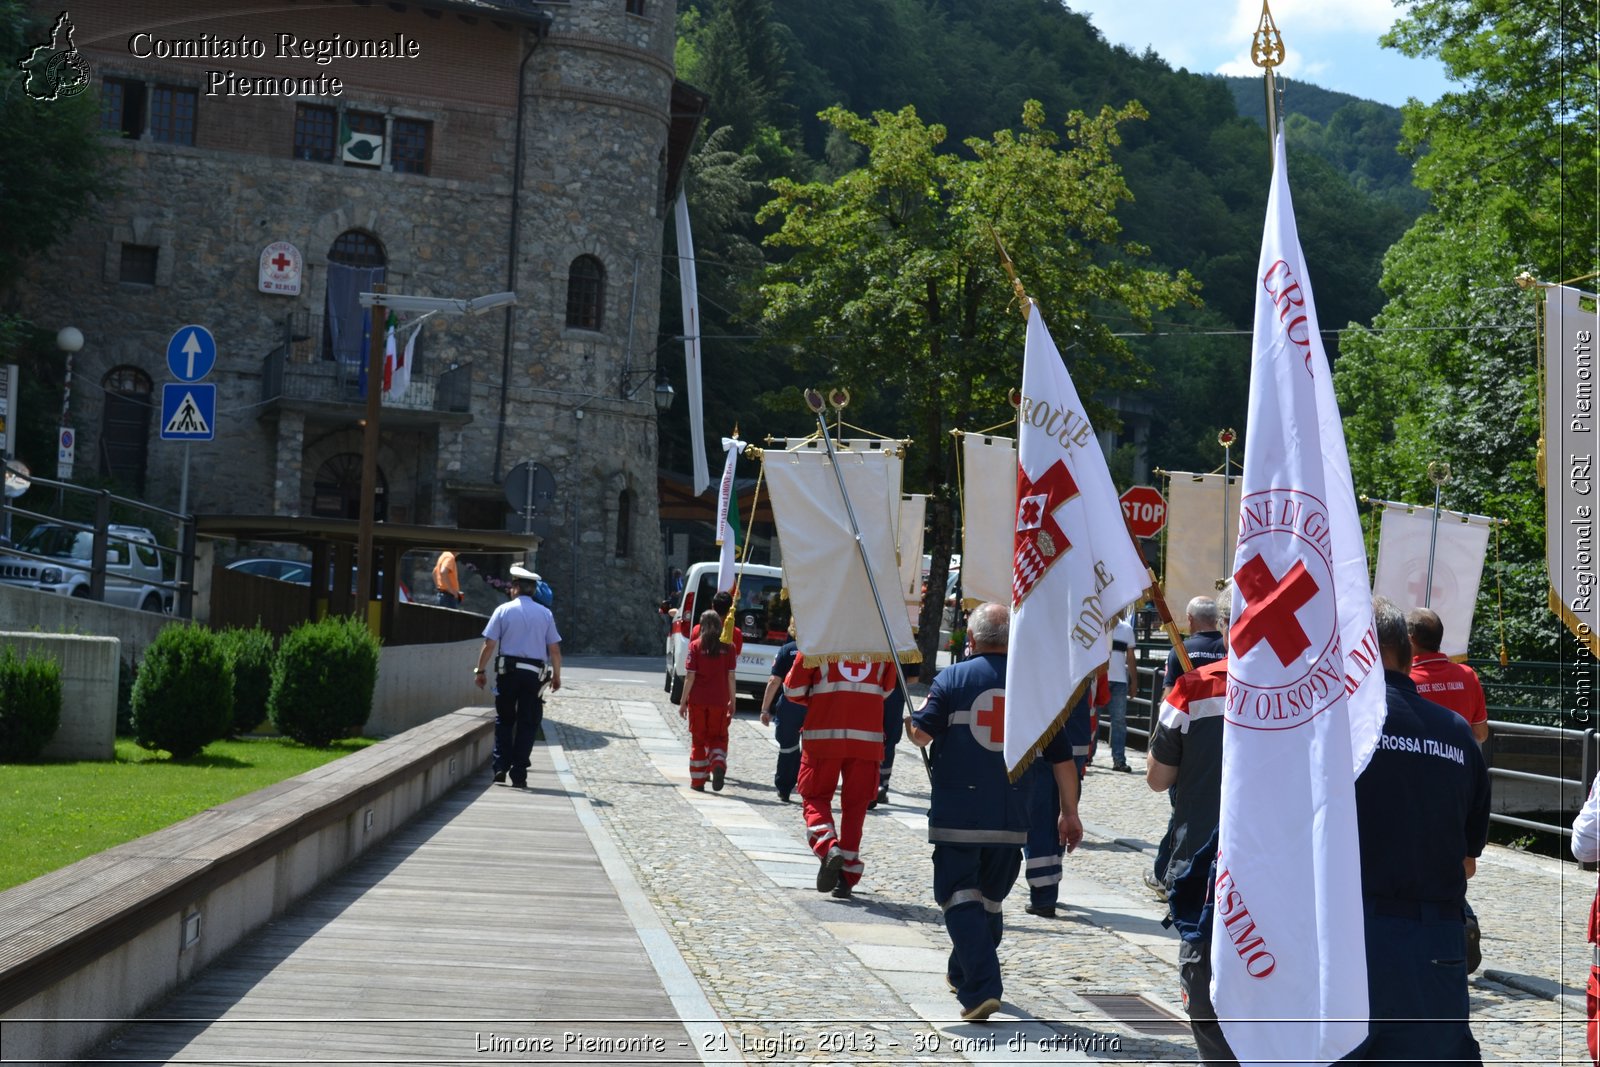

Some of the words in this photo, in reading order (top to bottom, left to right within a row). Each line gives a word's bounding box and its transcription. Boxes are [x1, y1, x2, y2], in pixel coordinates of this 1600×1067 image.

[1121, 501, 1164, 523] STOP
[1226, 680, 1249, 715] 18
[1256, 658, 1341, 721] AGOSTO
[1416, 684, 1432, 693] CROCE
[1432, 683, 1446, 692] ROSSA
[1447, 682, 1465, 691] ITALIANA
[1382, 735, 1421, 753] ROSSA
[1423, 739, 1465, 765] ITALIANA
[1215, 849, 1275, 978] ESIMO
